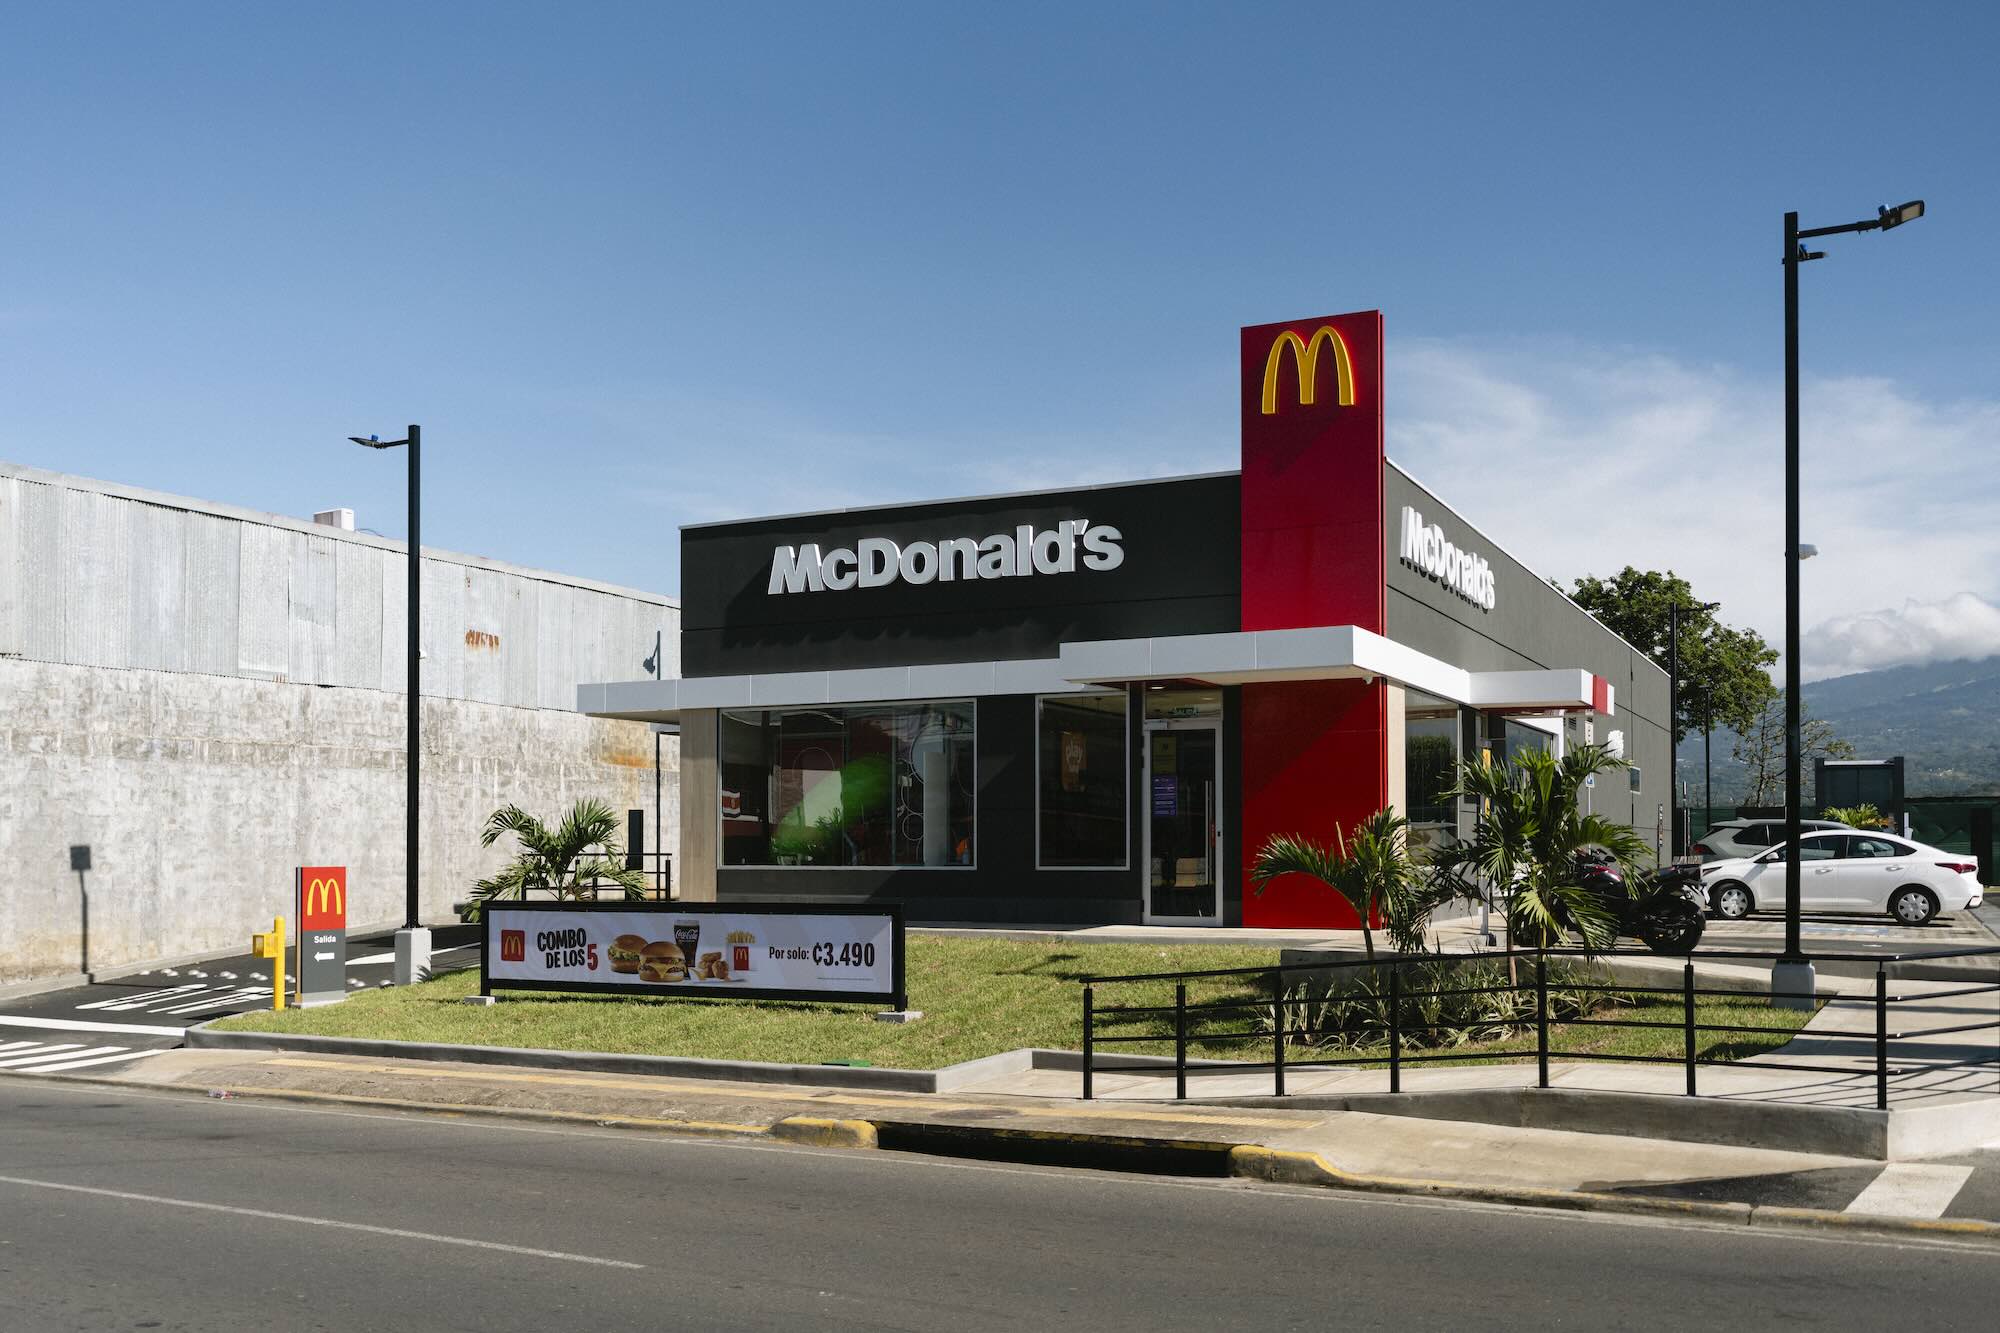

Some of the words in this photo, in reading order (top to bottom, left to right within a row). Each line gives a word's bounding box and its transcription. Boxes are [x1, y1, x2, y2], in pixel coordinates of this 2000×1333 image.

[767, 518, 1124, 596] McDonald's
[1400, 506, 1496, 610] McDonald's
[314, 934, 337, 944] Salida
[537, 928, 587, 952] COMBO
[545, 951, 561, 969] DE
[563, 948, 585, 967] LOS
[587, 943, 599, 971] 5
[769, 946, 784, 959] Por
[787, 946, 809, 960] solo:
